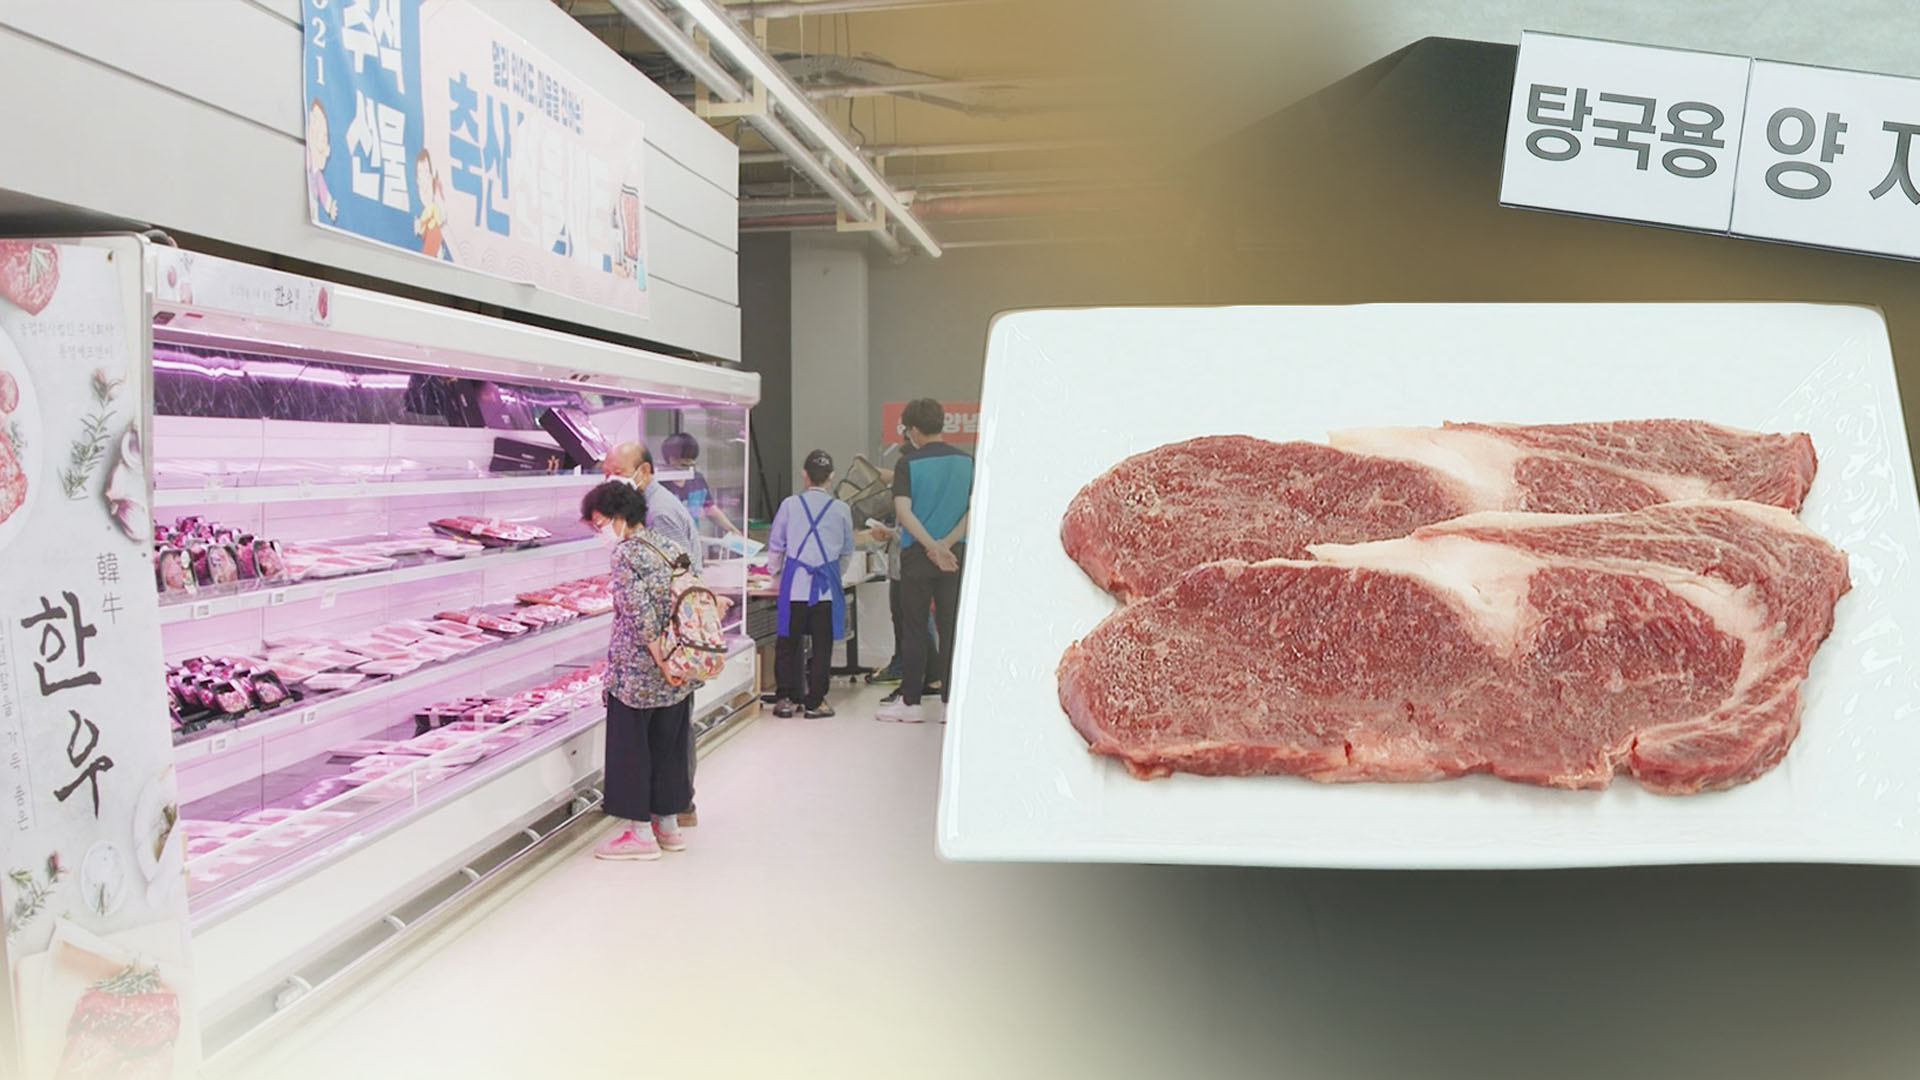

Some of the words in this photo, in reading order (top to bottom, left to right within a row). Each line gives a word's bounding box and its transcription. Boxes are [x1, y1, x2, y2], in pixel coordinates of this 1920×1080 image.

[341, 0, 405, 95] 추석
[345, 89, 411, 214] 선물
[1525, 83, 1726, 179] 탕국용
[20, 590, 114, 821] 한우
